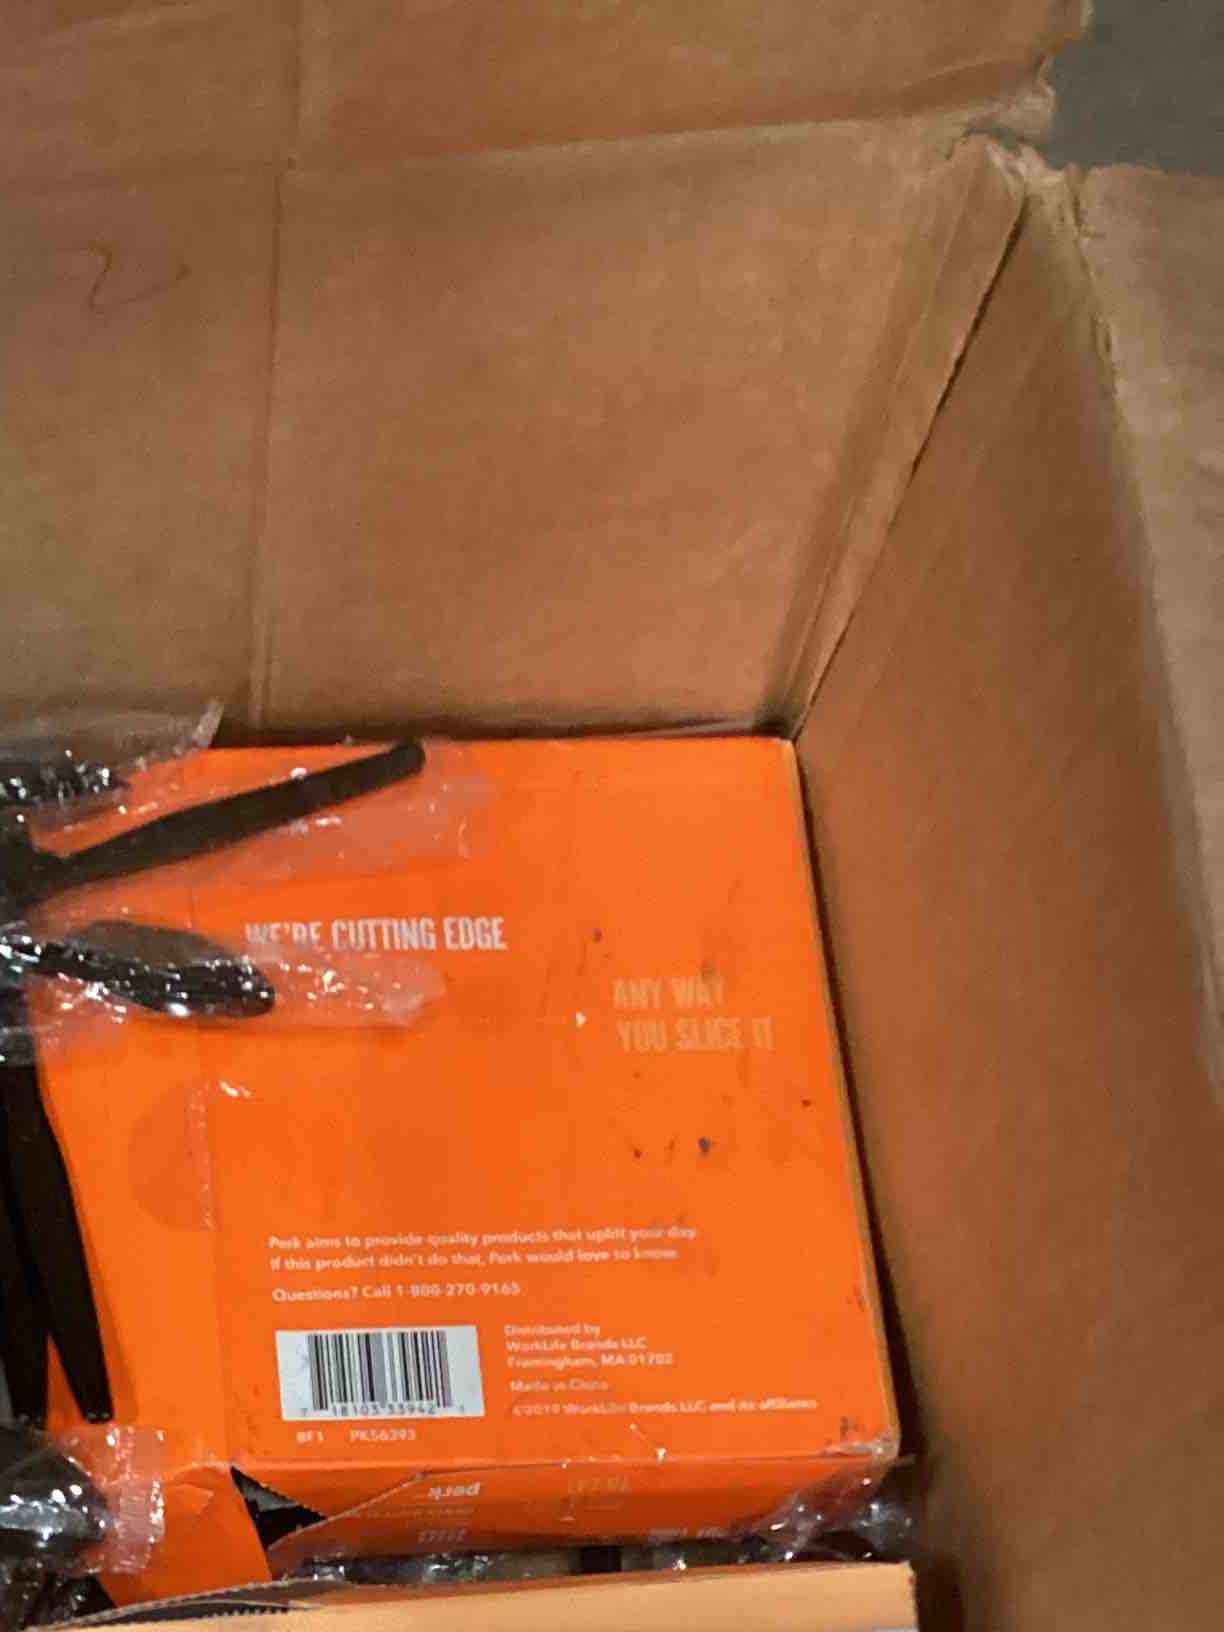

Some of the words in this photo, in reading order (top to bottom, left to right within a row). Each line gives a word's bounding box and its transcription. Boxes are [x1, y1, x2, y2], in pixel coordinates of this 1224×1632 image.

[246, 921, 321, 945] WE'RE
[332, 918, 436, 950] CUTTING
[444, 916, 507, 950] EDGE
[613, 978, 664, 1008] ANY
[616, 1019, 665, 1053] YOU
[676, 1017, 743, 1051] SLICE
[269, 1235, 301, 1249] Perk
[306, 1236, 341, 1249] aims
[345, 1234, 361, 1248] to
[365, 1232, 423, 1248] provide
[427, 1231, 477, 1249] quality
[482, 1229, 549, 1246] products
[552, 1229, 582, 1241] that
[284, 1256, 312, 1270] this
[315, 1254, 375, 1271] product
[428, 1252, 448, 1265] do
[489, 1251, 522, 1265] Perk
[526, 1249, 574, 1263] would
[578, 1248, 610, 1262] love
[614, 1247, 632, 1260] to
[272, 1286, 358, 1302] Questions?
[362, 1283, 392, 1298] Call
[621, 1336, 648, 1349] LLC
